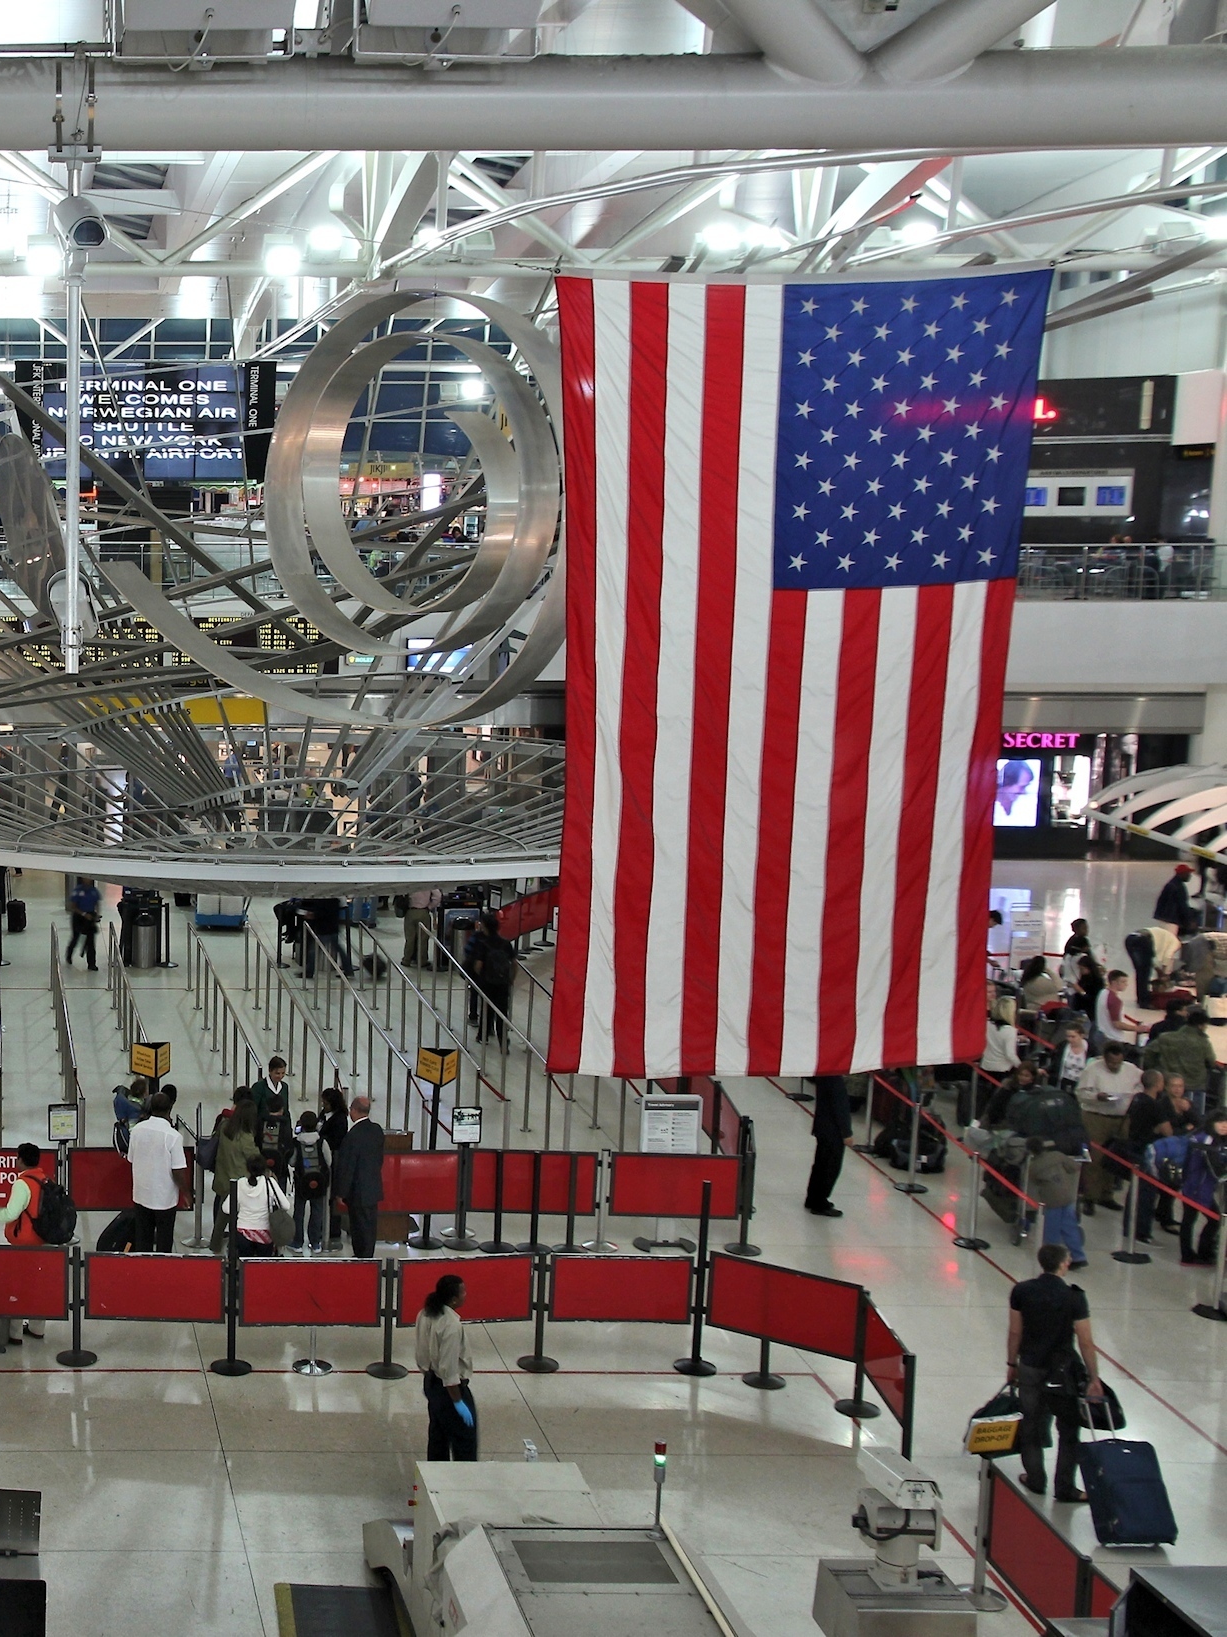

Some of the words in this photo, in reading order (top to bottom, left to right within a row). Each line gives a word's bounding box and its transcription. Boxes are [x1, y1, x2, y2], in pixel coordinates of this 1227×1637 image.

[33, 363, 41, 378] JFK
[59, 380, 172, 392] TERMINAL
[178, 380, 228, 392] ONE
[249, 365, 260, 406] TERMINAL
[79, 393, 210, 405] WELCOMES
[48, 406, 191, 418] NRWEGIAN
[198, 407, 237, 418] AIR
[248, 408, 258, 428] ONE
[93, 422, 194, 432] SHUTTLE
[101, 435, 153, 446] NEW
[159, 435, 223, 446] YORK
[42, 447, 66, 458] JF
[146, 448, 243, 459] AIRPORT
[1002, 732, 1081, 749] SECRET
[0, 1171, 21, 1185] PO
[976, 1425, 1013, 1434] BAGGAGE
